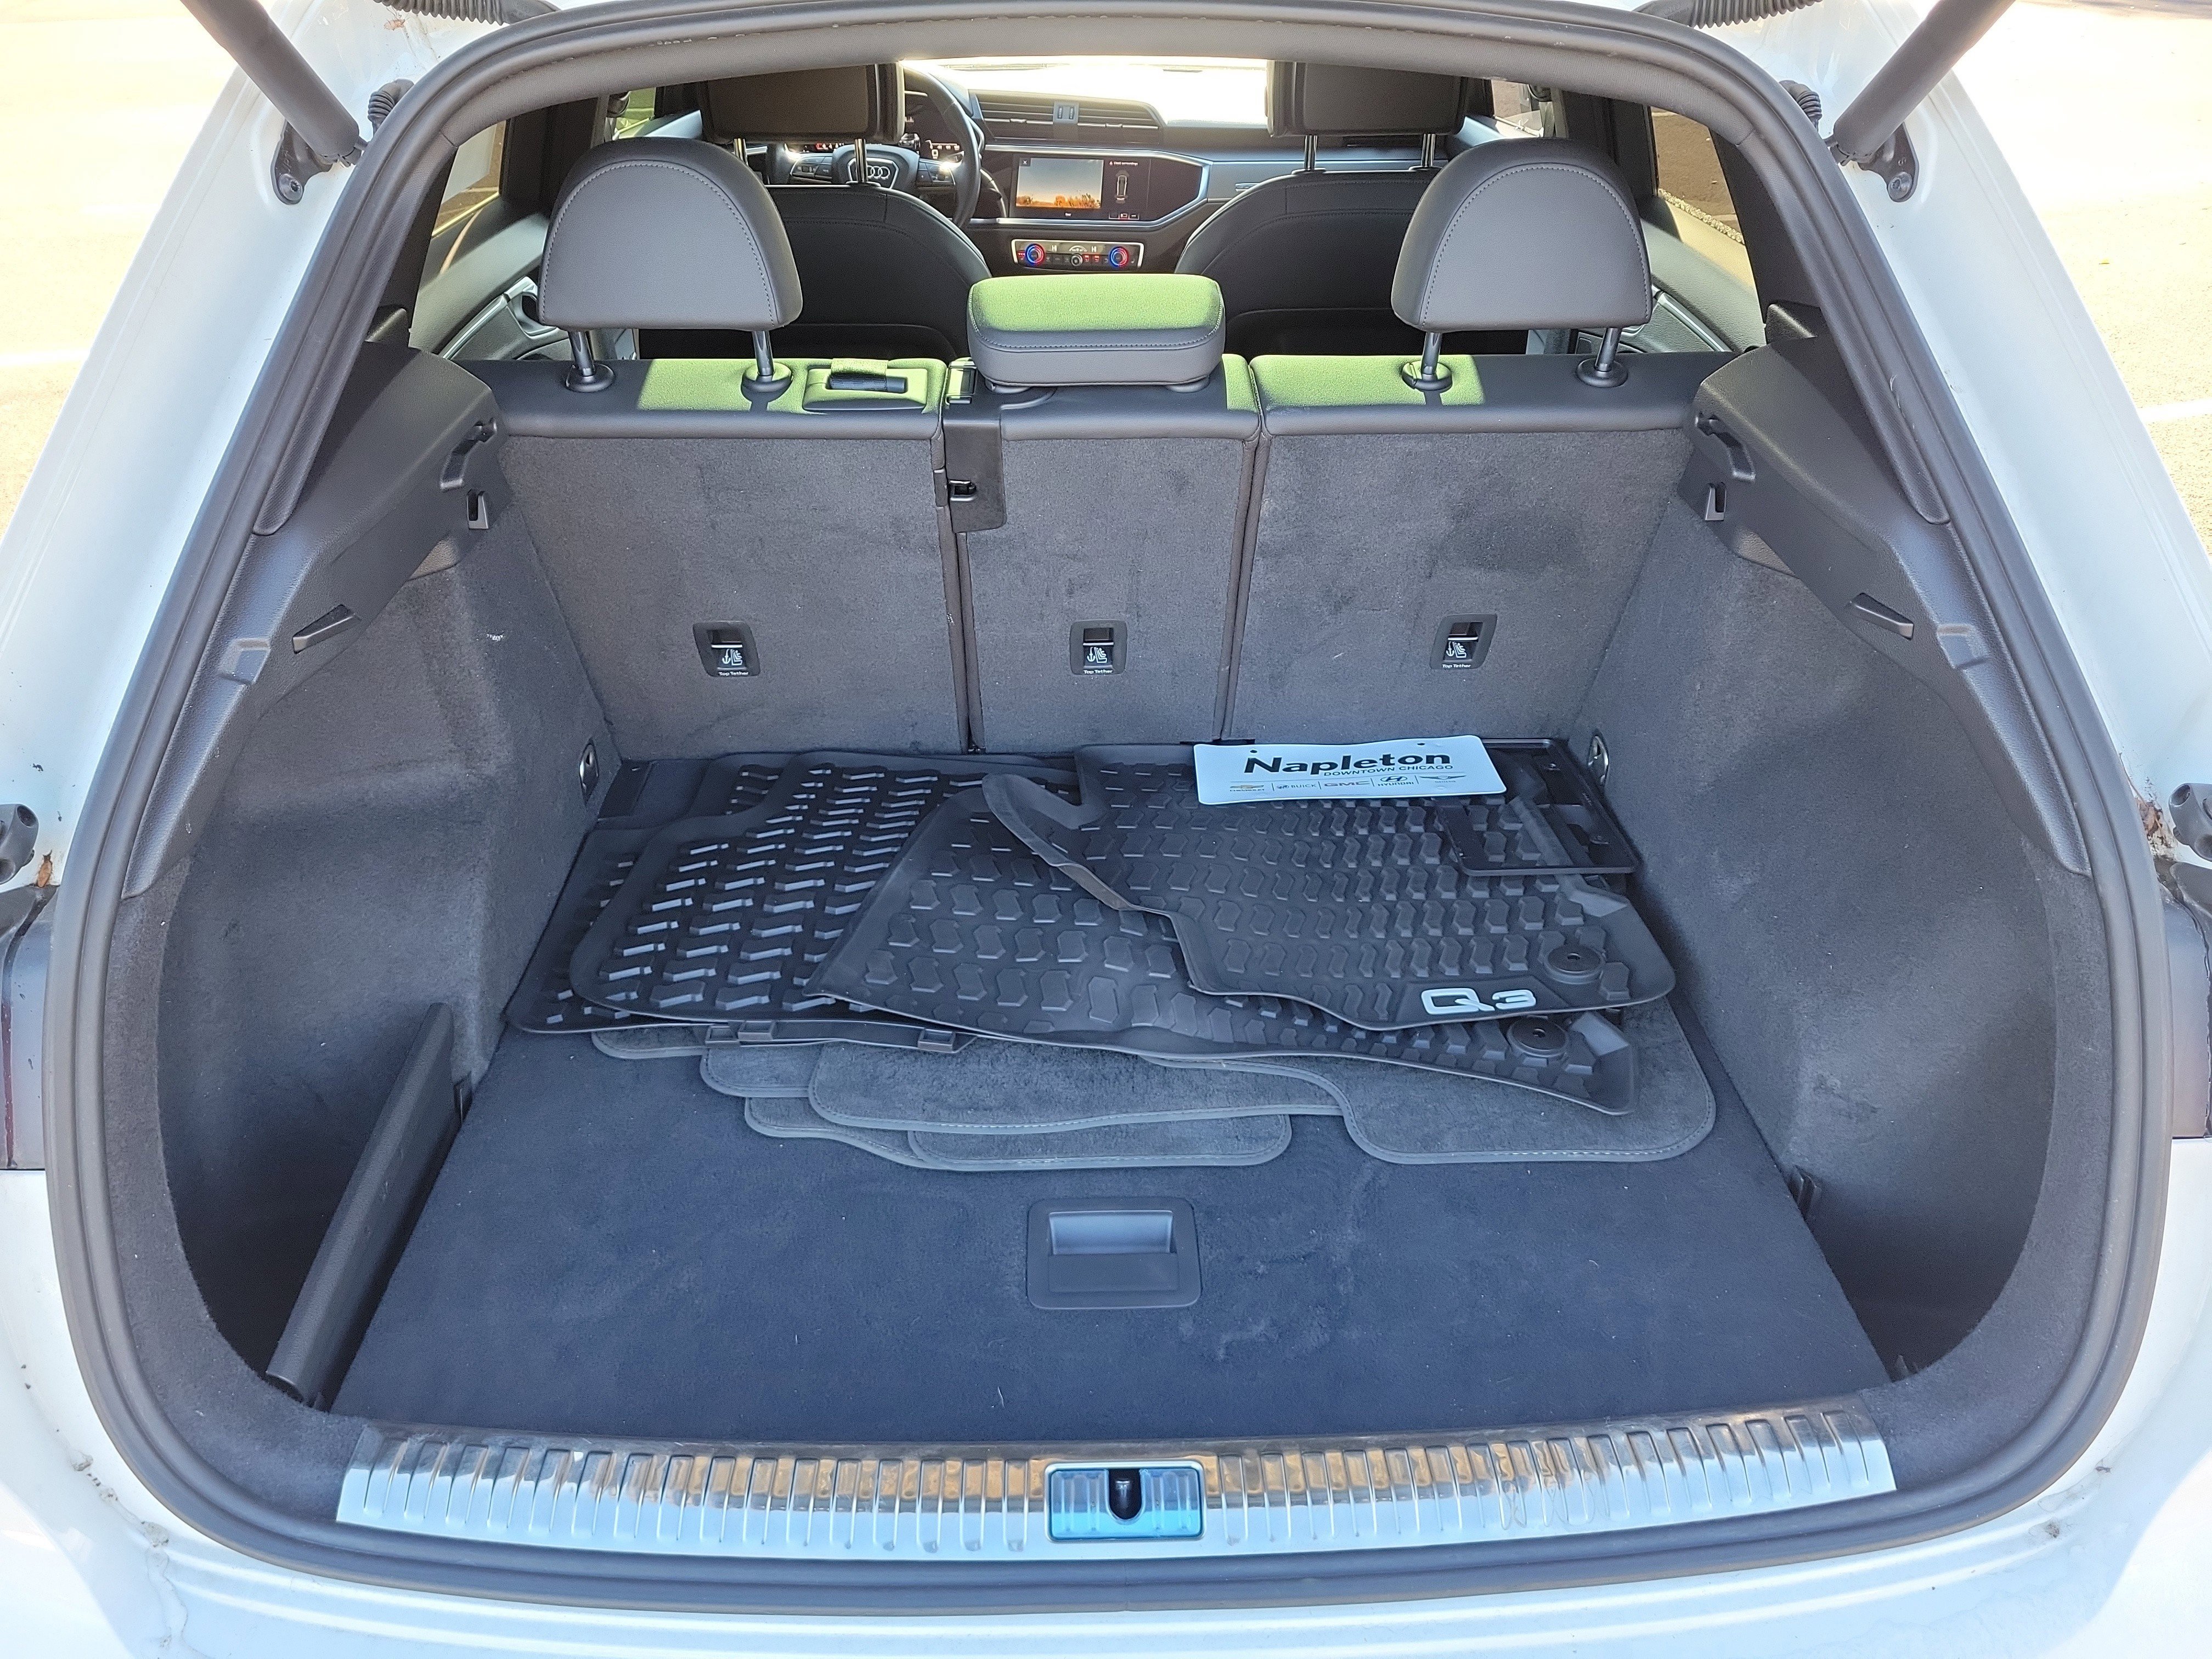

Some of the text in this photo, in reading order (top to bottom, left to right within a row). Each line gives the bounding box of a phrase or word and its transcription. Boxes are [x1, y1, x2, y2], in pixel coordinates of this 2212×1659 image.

[1244, 753, 1451, 775] Napleton
[1324, 767, 1395, 776] DOWNTOWN
[1421, 988, 1536, 1015] Q3
